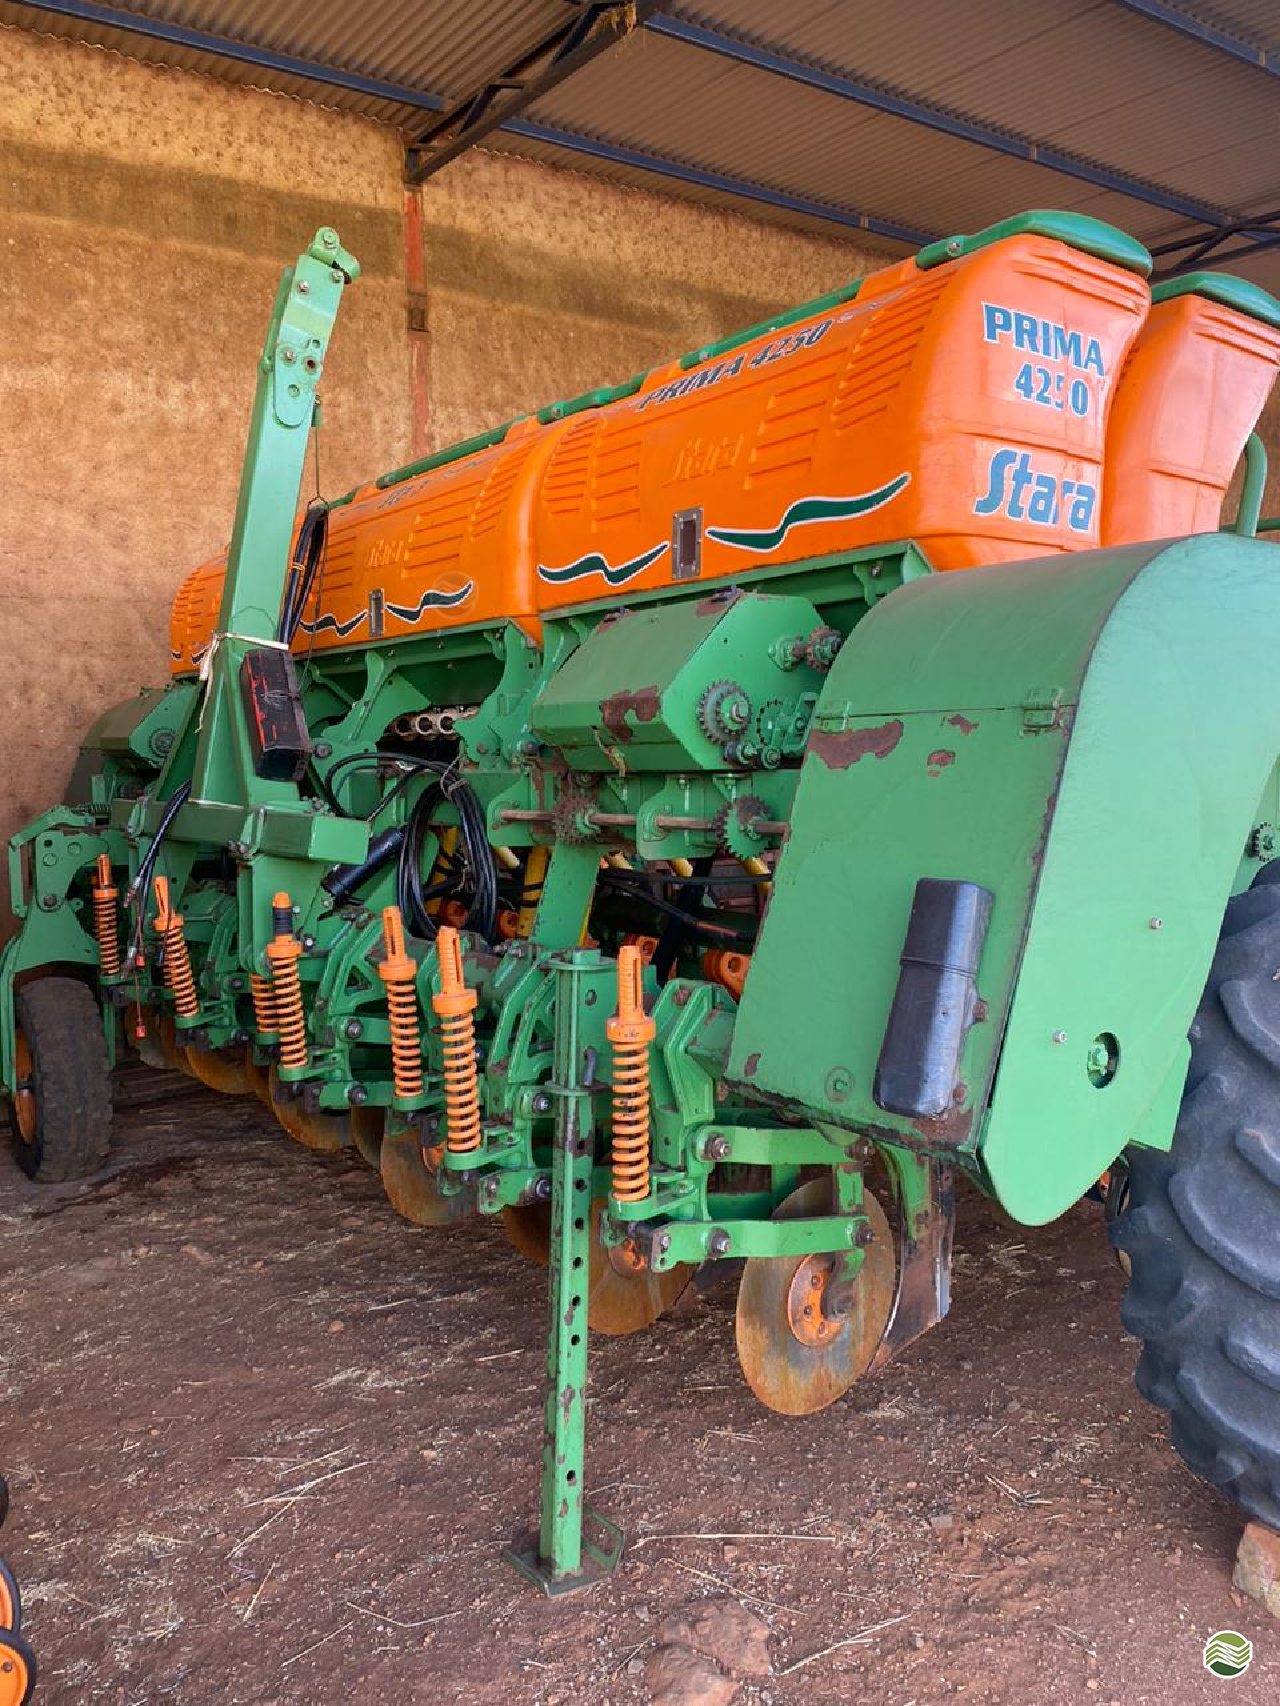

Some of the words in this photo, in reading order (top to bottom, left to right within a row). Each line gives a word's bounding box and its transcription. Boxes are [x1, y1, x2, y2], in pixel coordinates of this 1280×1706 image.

[636, 354, 748, 411] PRIMA
[749, 319, 833, 368] 4250
[983, 303, 1106, 377] PRIMA
[973, 448, 1097, 533] Stara
